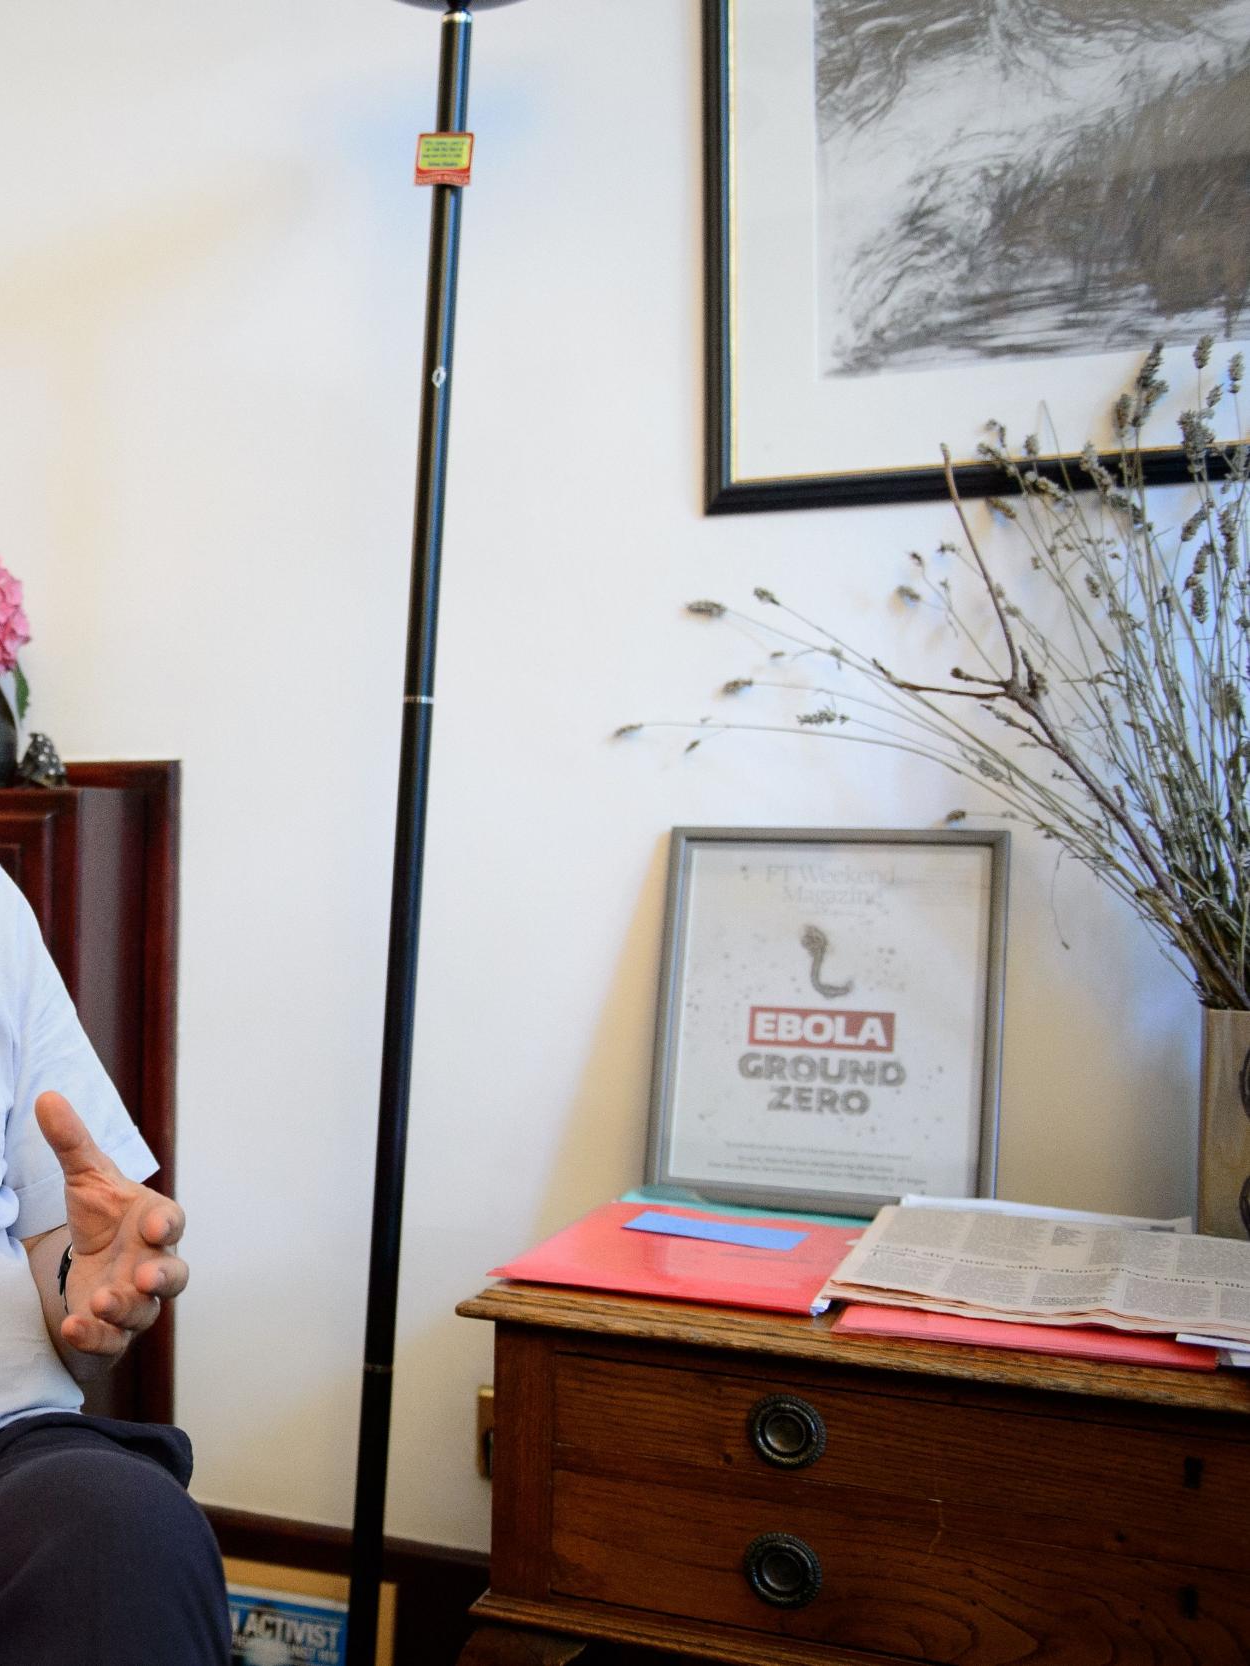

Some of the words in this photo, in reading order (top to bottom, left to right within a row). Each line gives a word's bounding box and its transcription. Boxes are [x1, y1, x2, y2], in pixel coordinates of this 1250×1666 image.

[765, 864, 793, 883] FT
[798, 863, 896, 886] Weekend
[783, 886, 884, 908] Magazine
[753, 1011, 888, 1047] EBOLA
[738, 1052, 907, 1088] GROUND
[767, 1084, 871, 1116] ZERO
